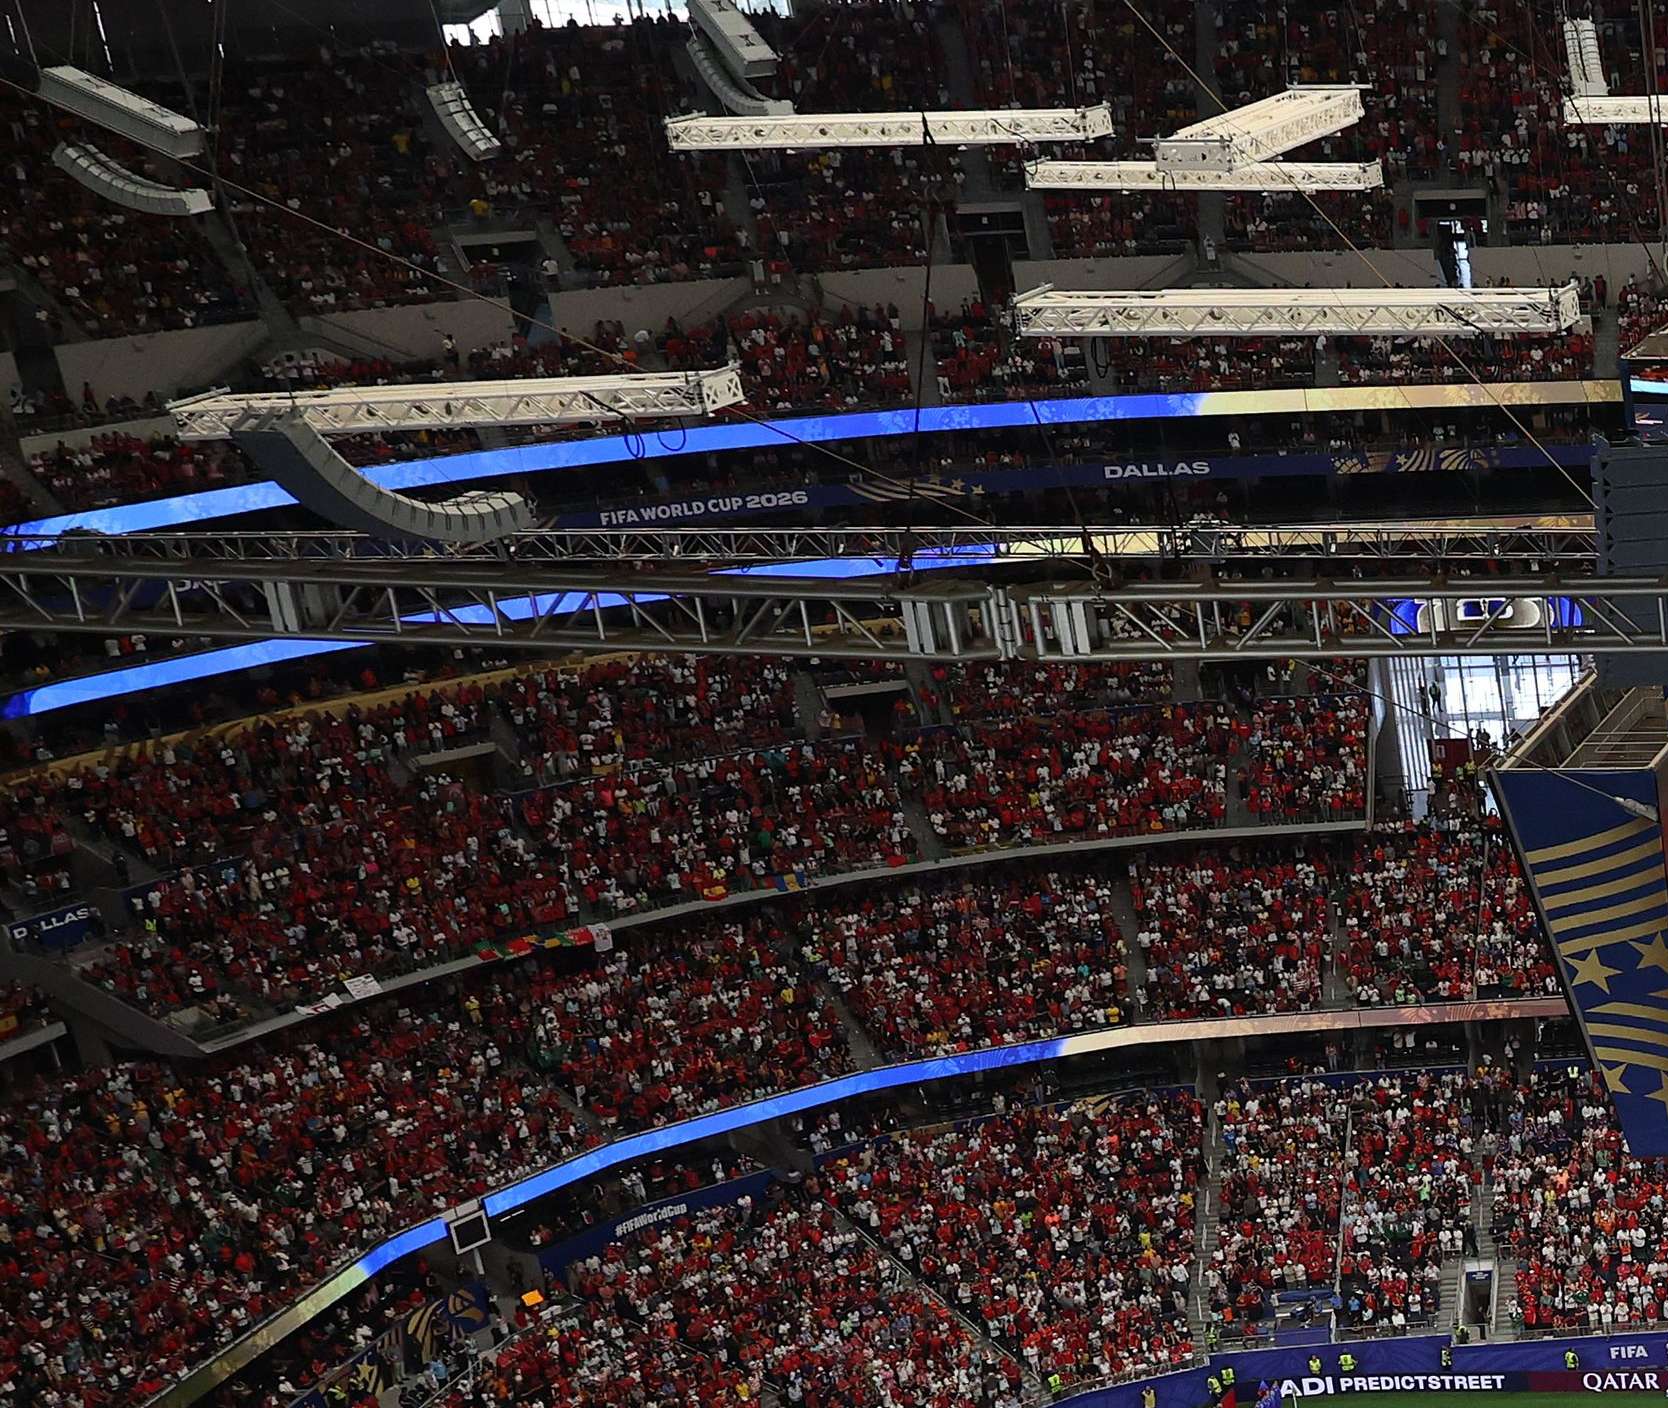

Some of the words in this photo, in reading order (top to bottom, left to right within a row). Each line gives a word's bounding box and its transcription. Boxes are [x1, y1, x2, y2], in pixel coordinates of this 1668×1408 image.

[1103, 461, 1210, 479] DALLAS
[600, 510, 640, 526] FIFA
[640, 500, 705, 521] WORLD
[706, 497, 744, 513] CUP
[745, 490, 809, 510] 2026
[12, 907, 89, 940] DLLAS
[1609, 1345, 1649, 1360] FIFA
[1279, 1376, 1333, 1398] ADI
[1339, 1374, 1505, 1392] PREDICTSTREET
[1582, 1371, 1660, 1392] QATAR
